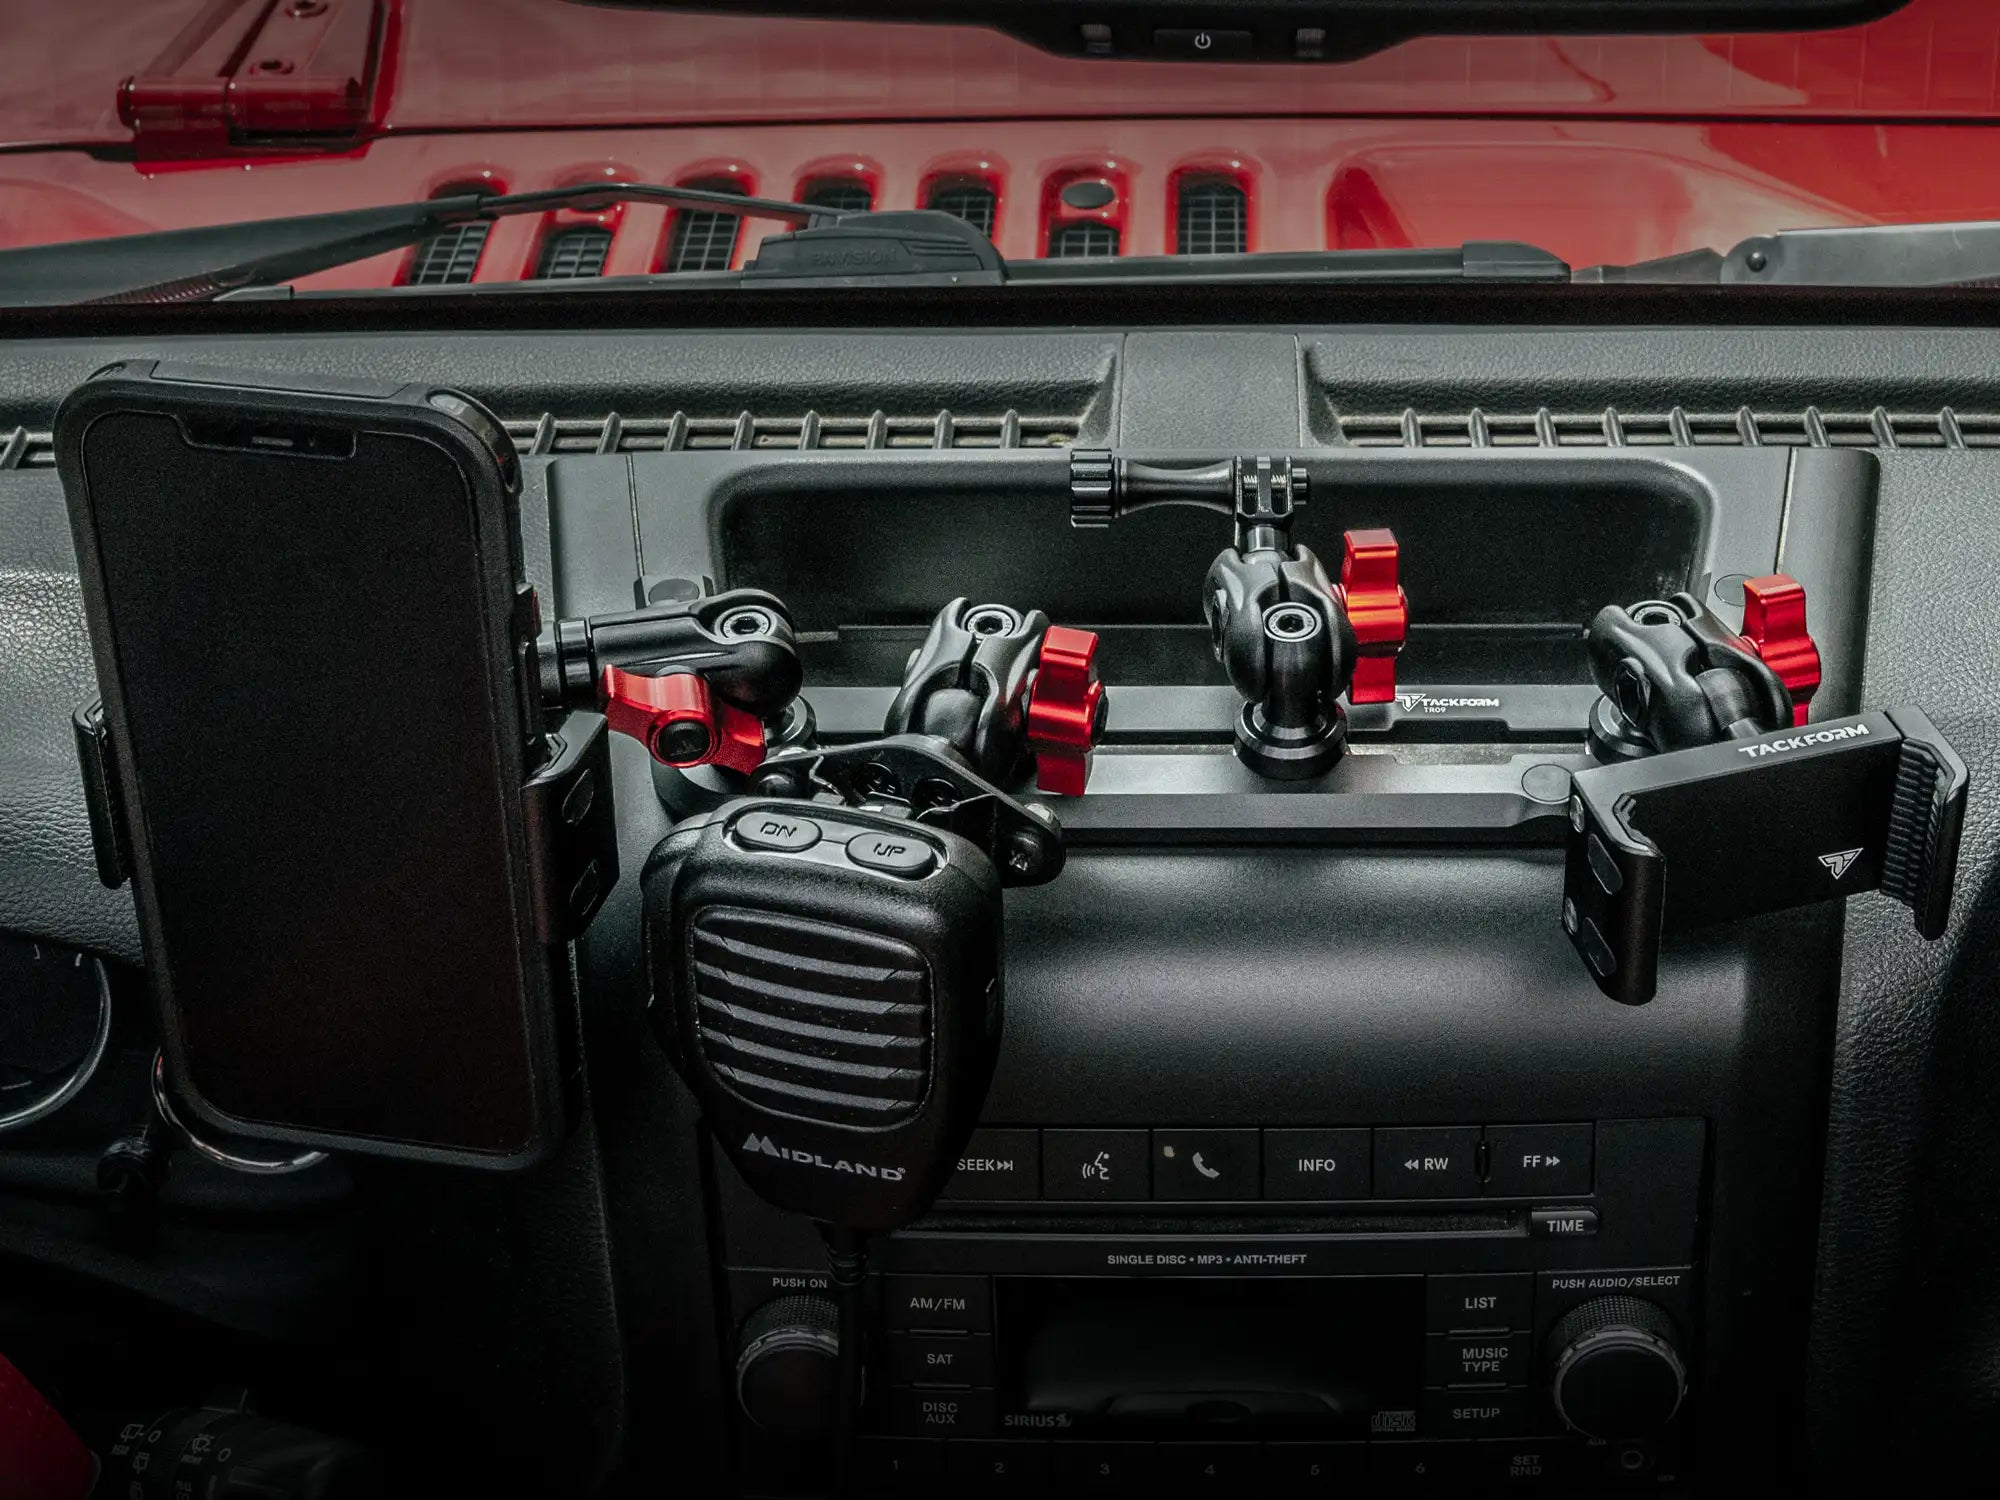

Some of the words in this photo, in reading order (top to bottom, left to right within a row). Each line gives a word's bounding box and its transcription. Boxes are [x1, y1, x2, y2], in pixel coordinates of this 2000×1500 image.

[1421, 698, 1500, 707] TACKFORM
[1737, 723, 1870, 758] TACKFORM
[873, 842, 906, 857] UP
[742, 1132, 905, 1181] MIDLAND
[1523, 1155, 1542, 1168] FF
[956, 1158, 996, 1171] SEEK
[1298, 1158, 1336, 1172] INFO
[1423, 1157, 1449, 1170] RW
[1547, 1218, 1584, 1233] TIME
[1107, 1254, 1154, 1265] SINGLE
[1156, 1254, 1187, 1265] DISC
[1197, 1254, 1223, 1265] MP3
[1233, 1253, 1308, 1265] ANTI-THEFT
[771, 1277, 806, 1289] PUSH
[809, 1278, 828, 1289] ON
[1552, 1279, 1586, 1289] PUSH
[1588, 1275, 1681, 1288] AUDIO/SELECT
[909, 1297, 966, 1311] AM/FM
[1465, 1296, 1497, 1309] LIST
[926, 1352, 954, 1365] SAT
[1462, 1347, 1509, 1360] MUSIC
[1463, 1360, 1500, 1373] TYPE
[922, 1401, 959, 1413] DISC
[1452, 1407, 1501, 1419] SETUP
[925, 1413, 957, 1425] AUX
[1003, 1414, 1056, 1428] SIRIUS
[890, 1458, 900, 1473] 1
[1511, 1454, 1541, 1465] SET
[993, 1461, 1006, 1475] 2
[1099, 1463, 1111, 1476] 3
[1203, 1463, 1216, 1476] 4
[1309, 1463, 1321, 1476] 5
[1415, 1462, 1426, 1475] 6
[1509, 1465, 1543, 1477] RND
